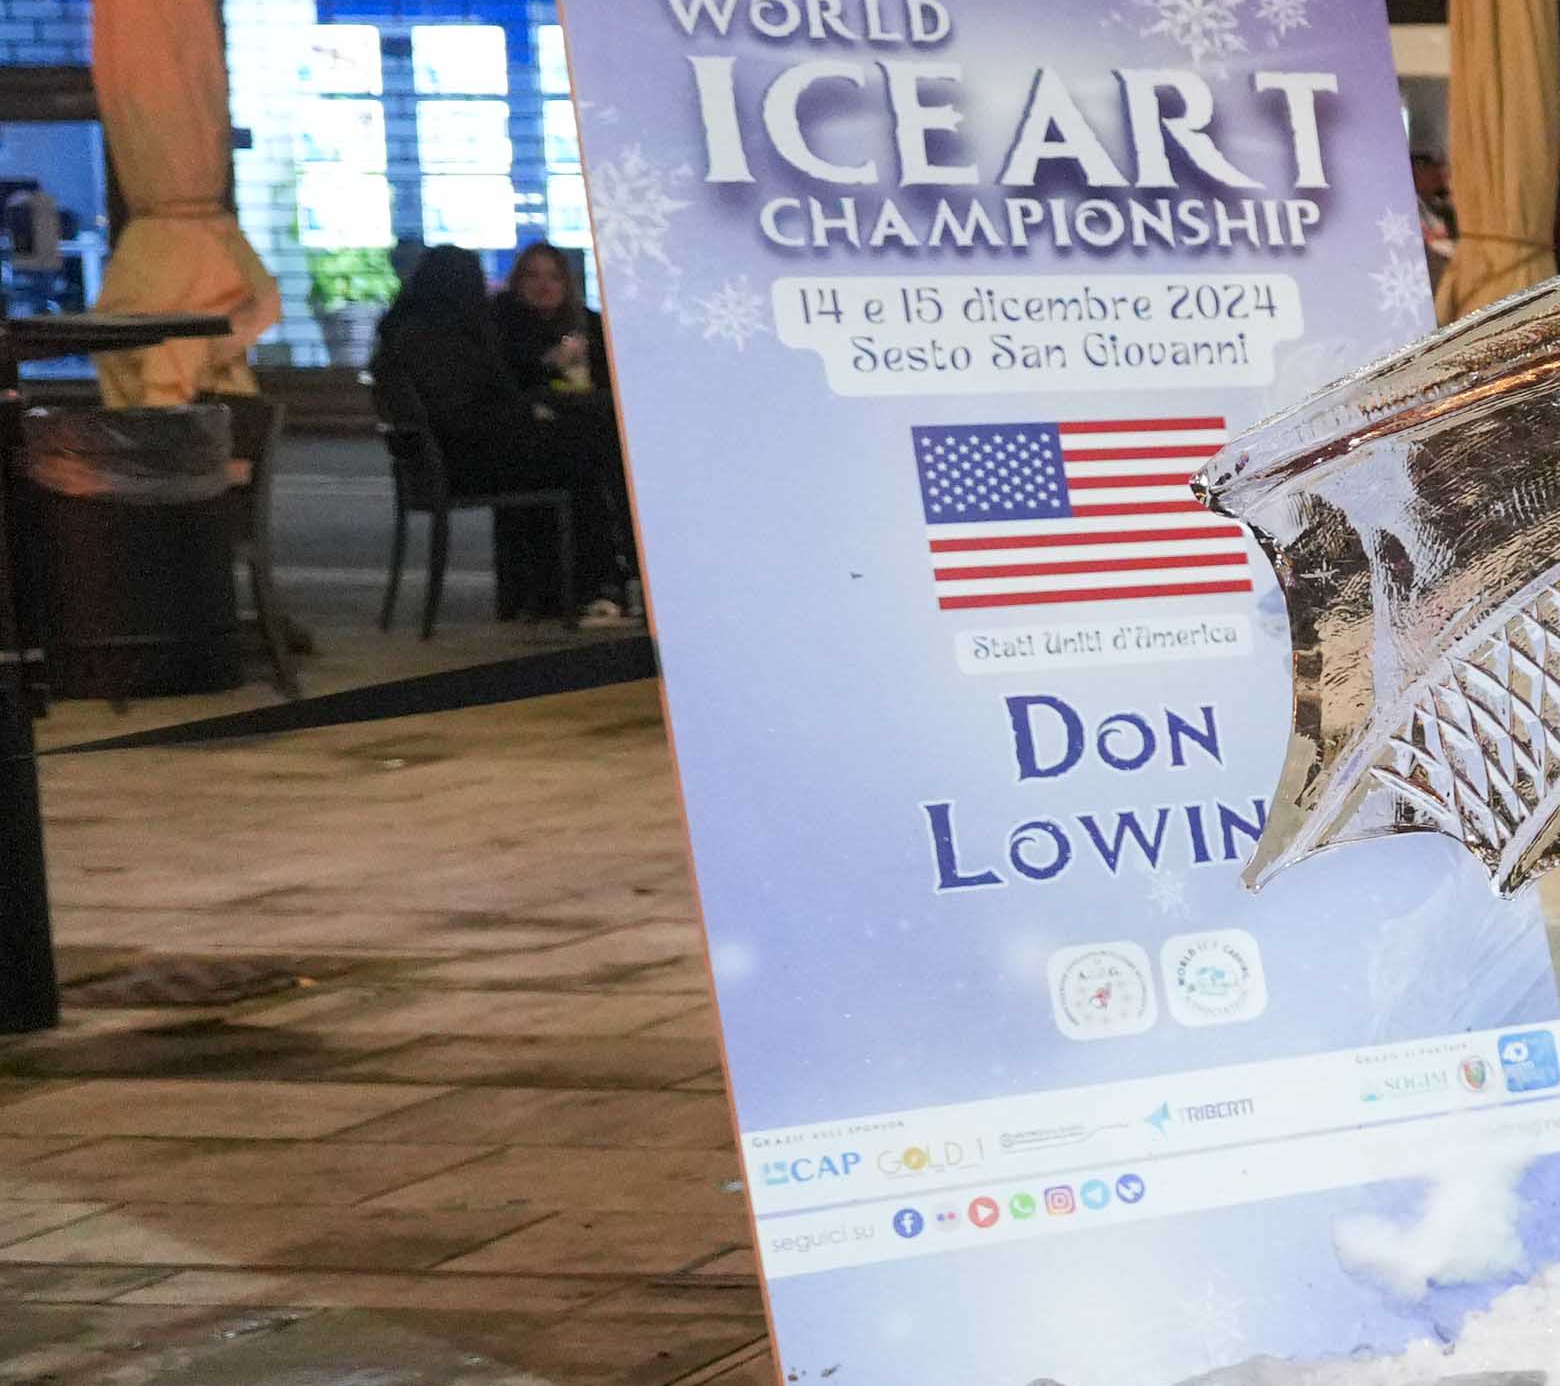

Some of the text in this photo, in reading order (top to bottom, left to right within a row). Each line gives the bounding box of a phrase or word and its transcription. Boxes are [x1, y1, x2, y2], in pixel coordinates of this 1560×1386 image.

[759, 195, 1322, 250] CHAMPIONSHIP
[799, 284, 1278, 324] 14 e 15 dicembre 2024
[851, 331, 1250, 373] Sesto San Giovanni
[972, 633, 1034, 662] Stati
[1044, 631, 1102, 656] Uniti
[923, 798, 1267, 890] LOWIN
[791, 1151, 862, 1183] CAP
[771, 1225, 876, 1254] seguici su
